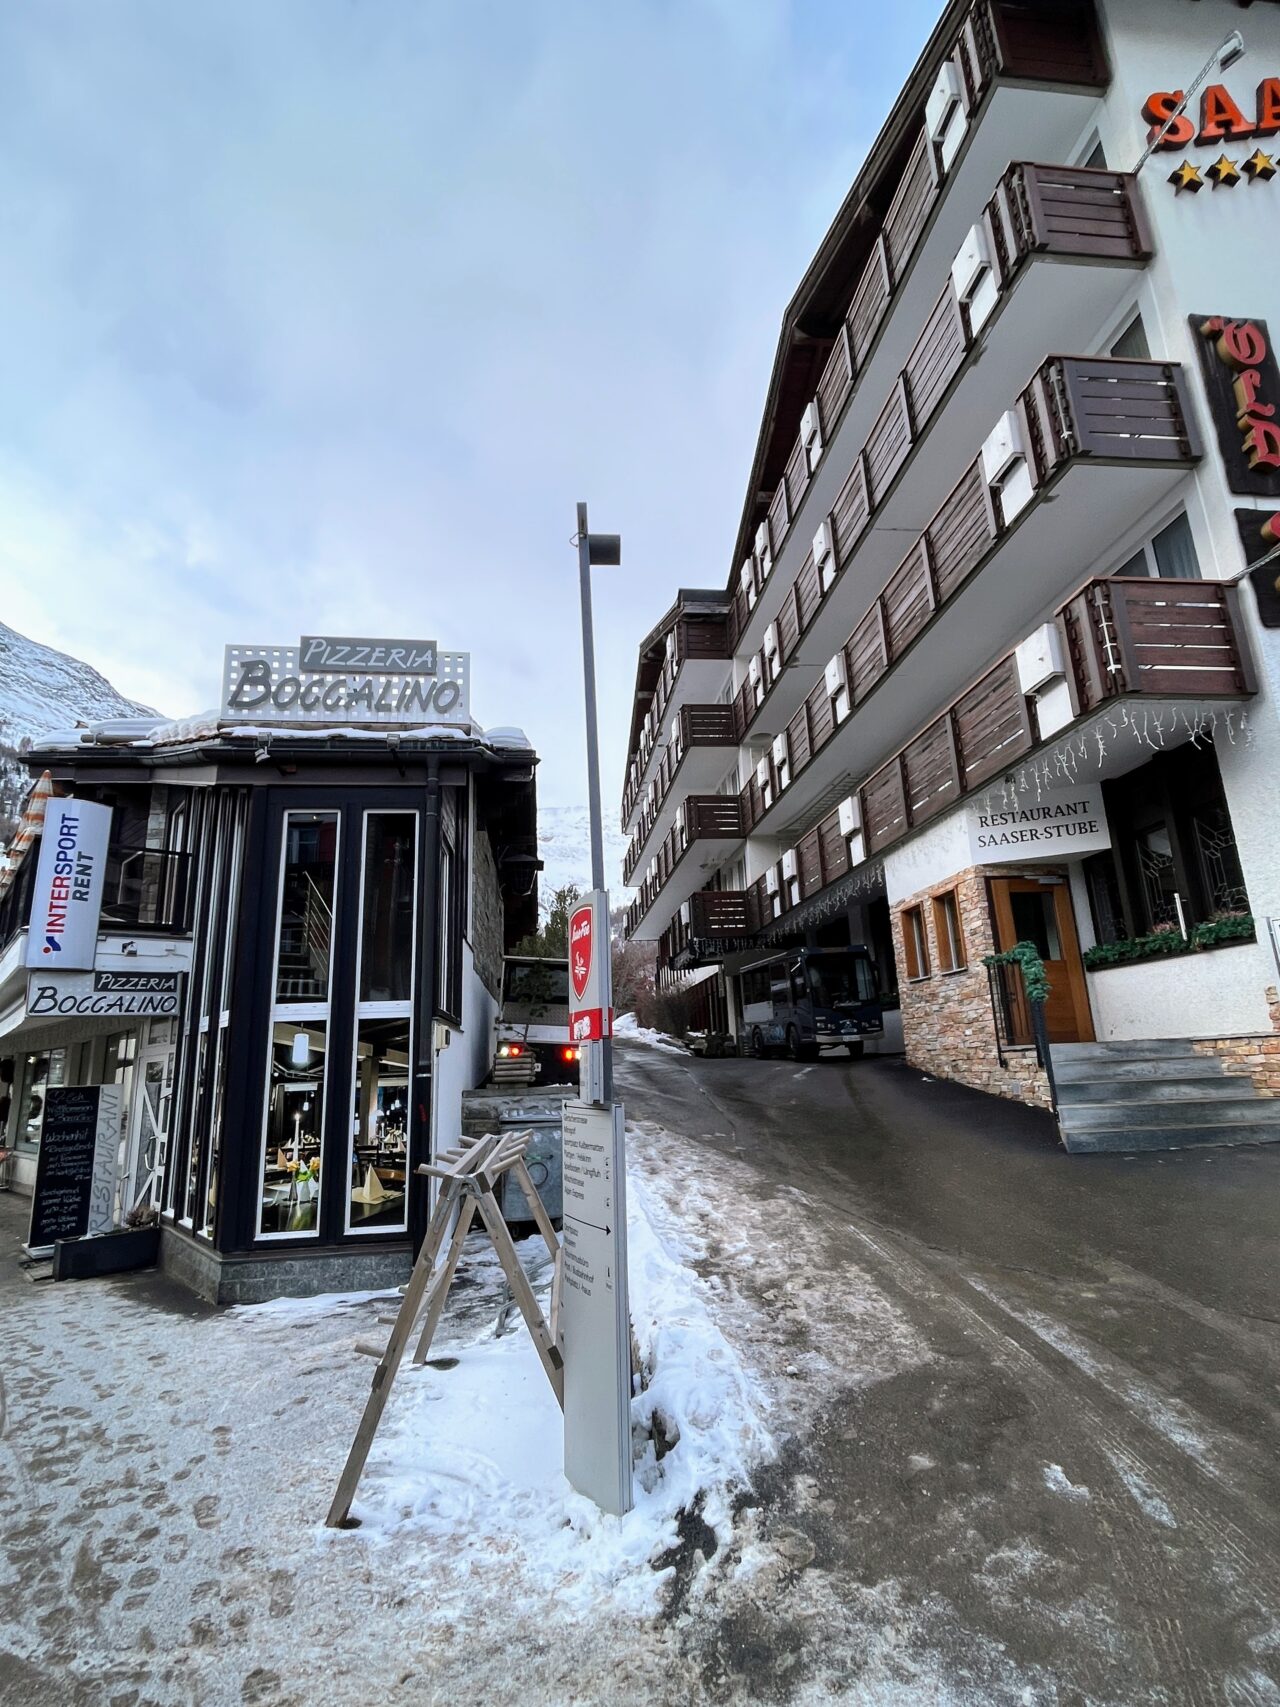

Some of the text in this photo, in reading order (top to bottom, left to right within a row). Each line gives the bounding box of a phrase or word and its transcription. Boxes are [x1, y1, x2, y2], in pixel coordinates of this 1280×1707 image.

[304, 638, 432, 669] PIZZERIA
[227, 659, 460, 714] BOCCALINO
[979, 801, 1090, 828] RESTAURANT
[978, 820, 1099, 848] SAASER-STUBE
[46, 813, 80, 934] INTERSPORT
[72, 851, 94, 902] RENT
[98, 973, 175, 991] PIZZERIA
[29, 986, 177, 1014] BOCCALINO
[89, 1088, 118, 1234] RESTAURANT
